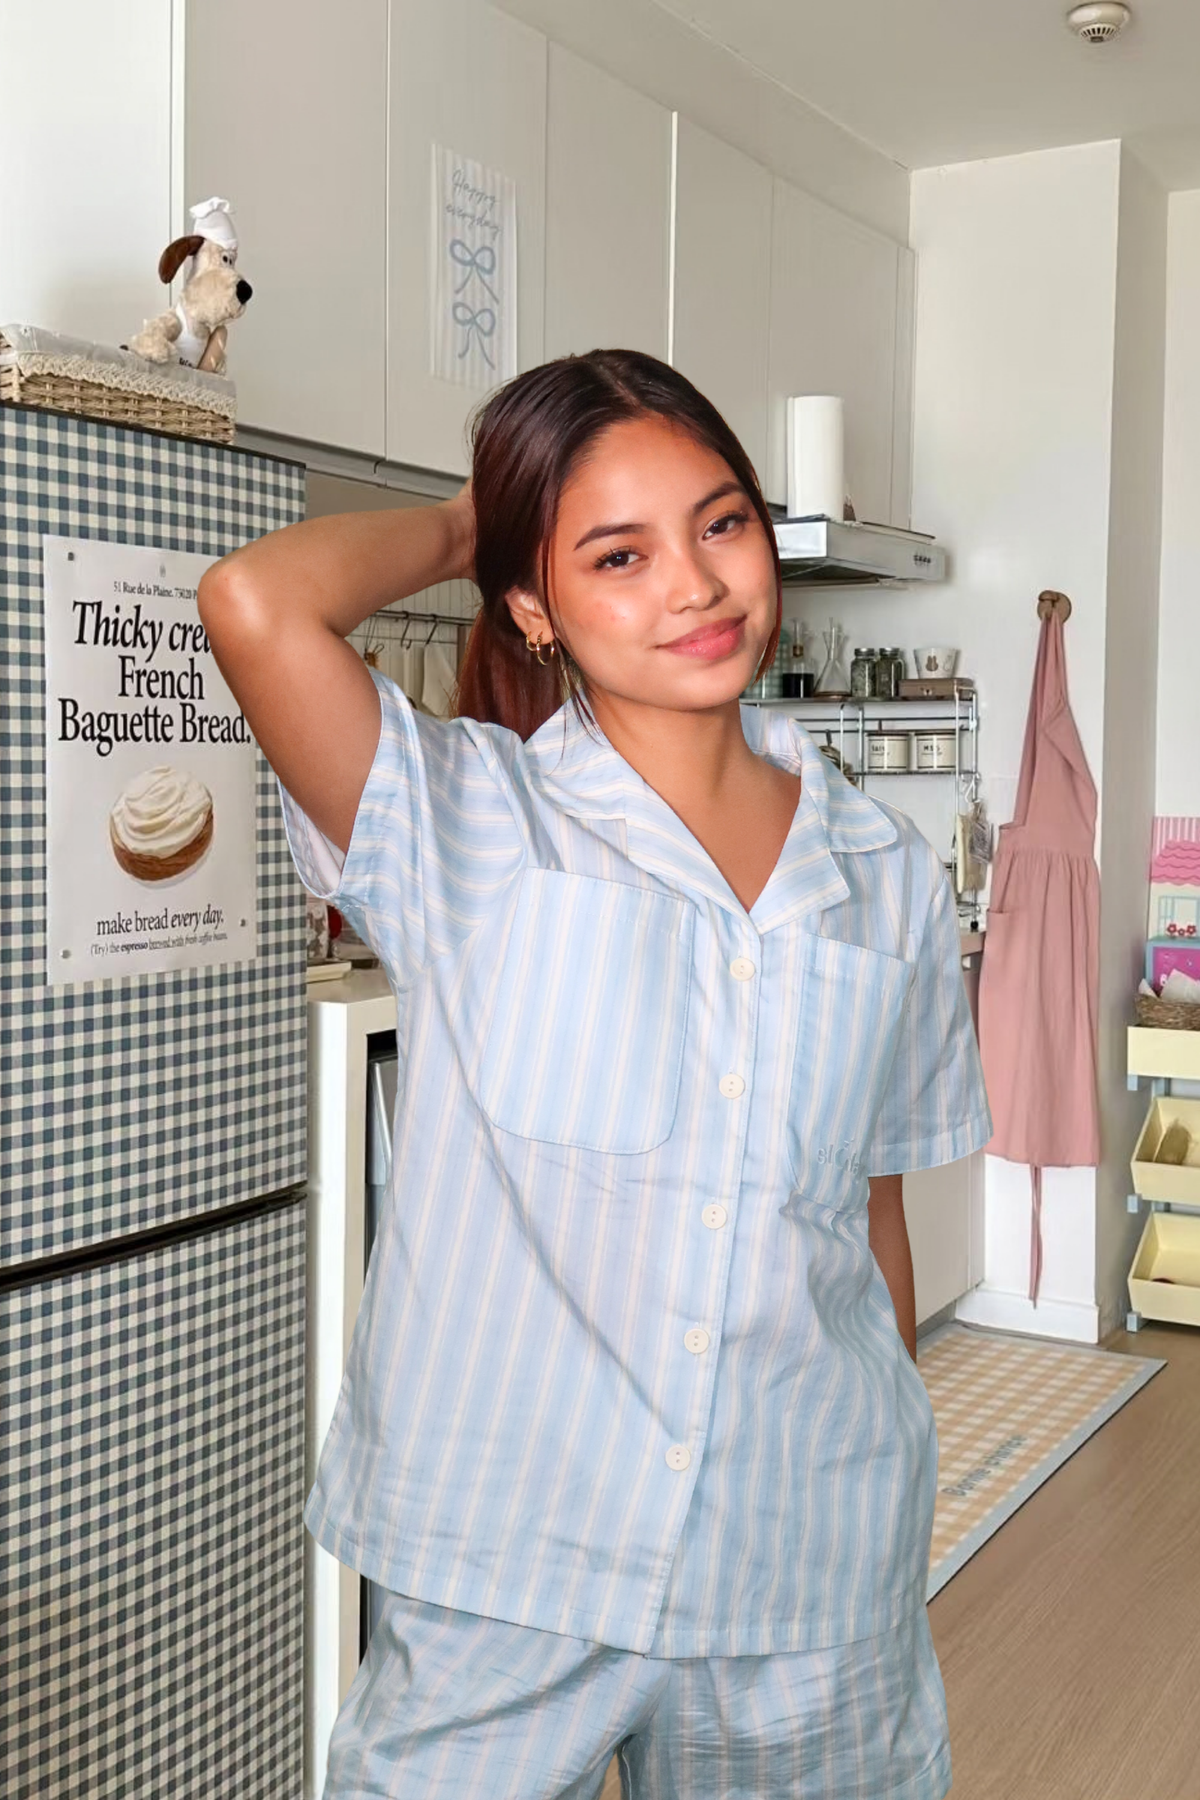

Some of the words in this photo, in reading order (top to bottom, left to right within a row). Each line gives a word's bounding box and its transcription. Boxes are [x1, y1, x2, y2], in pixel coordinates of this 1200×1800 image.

[123, 582, 137, 594] Rue
[137, 582, 146, 596] de
[146, 584, 152, 596] la
[73, 600, 163, 663] Thicky
[118, 655, 205, 700] French
[57, 698, 174, 758] Baguette
[179, 702, 252, 745] Bread.
[96, 911, 133, 936] make
[134, 907, 169, 932] bread
[170, 911, 202, 932] every
[202, 903, 224, 930] day.
[90, 943, 109, 957] (Try)
[120, 942, 149, 955] espresso
